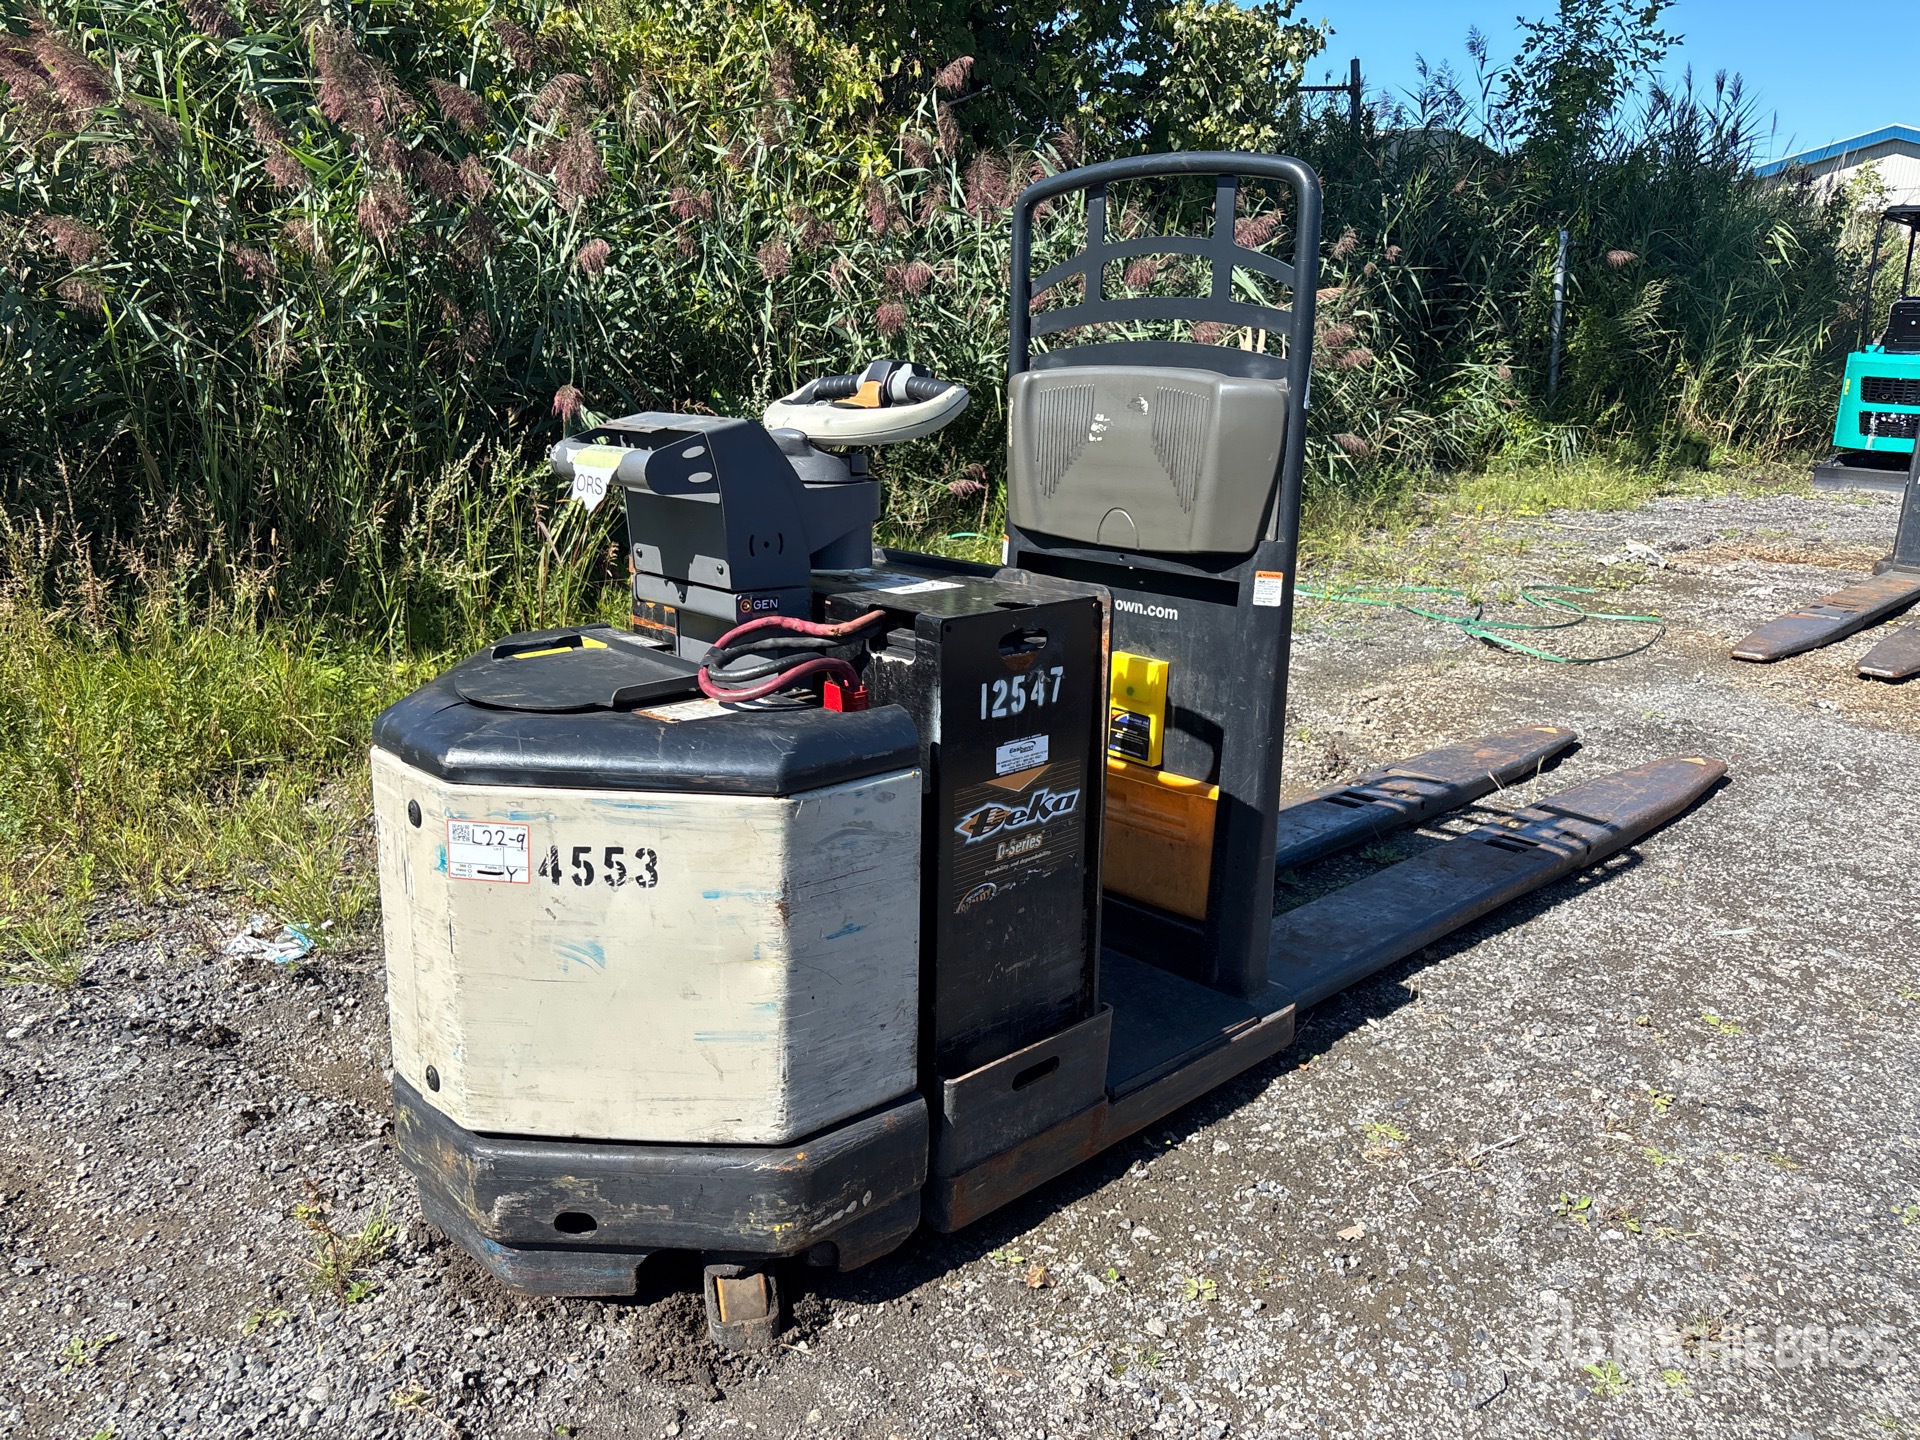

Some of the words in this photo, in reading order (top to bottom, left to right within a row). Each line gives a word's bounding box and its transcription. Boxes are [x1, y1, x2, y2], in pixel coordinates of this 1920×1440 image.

[1114, 599, 1179, 621] own.com
[980, 665, 1064, 720] 12547
[958, 789, 1078, 842] Deka
[472, 829, 526, 851] L22-9
[996, 833, 1043, 861] D-Series
[537, 845, 659, 889] 4553
